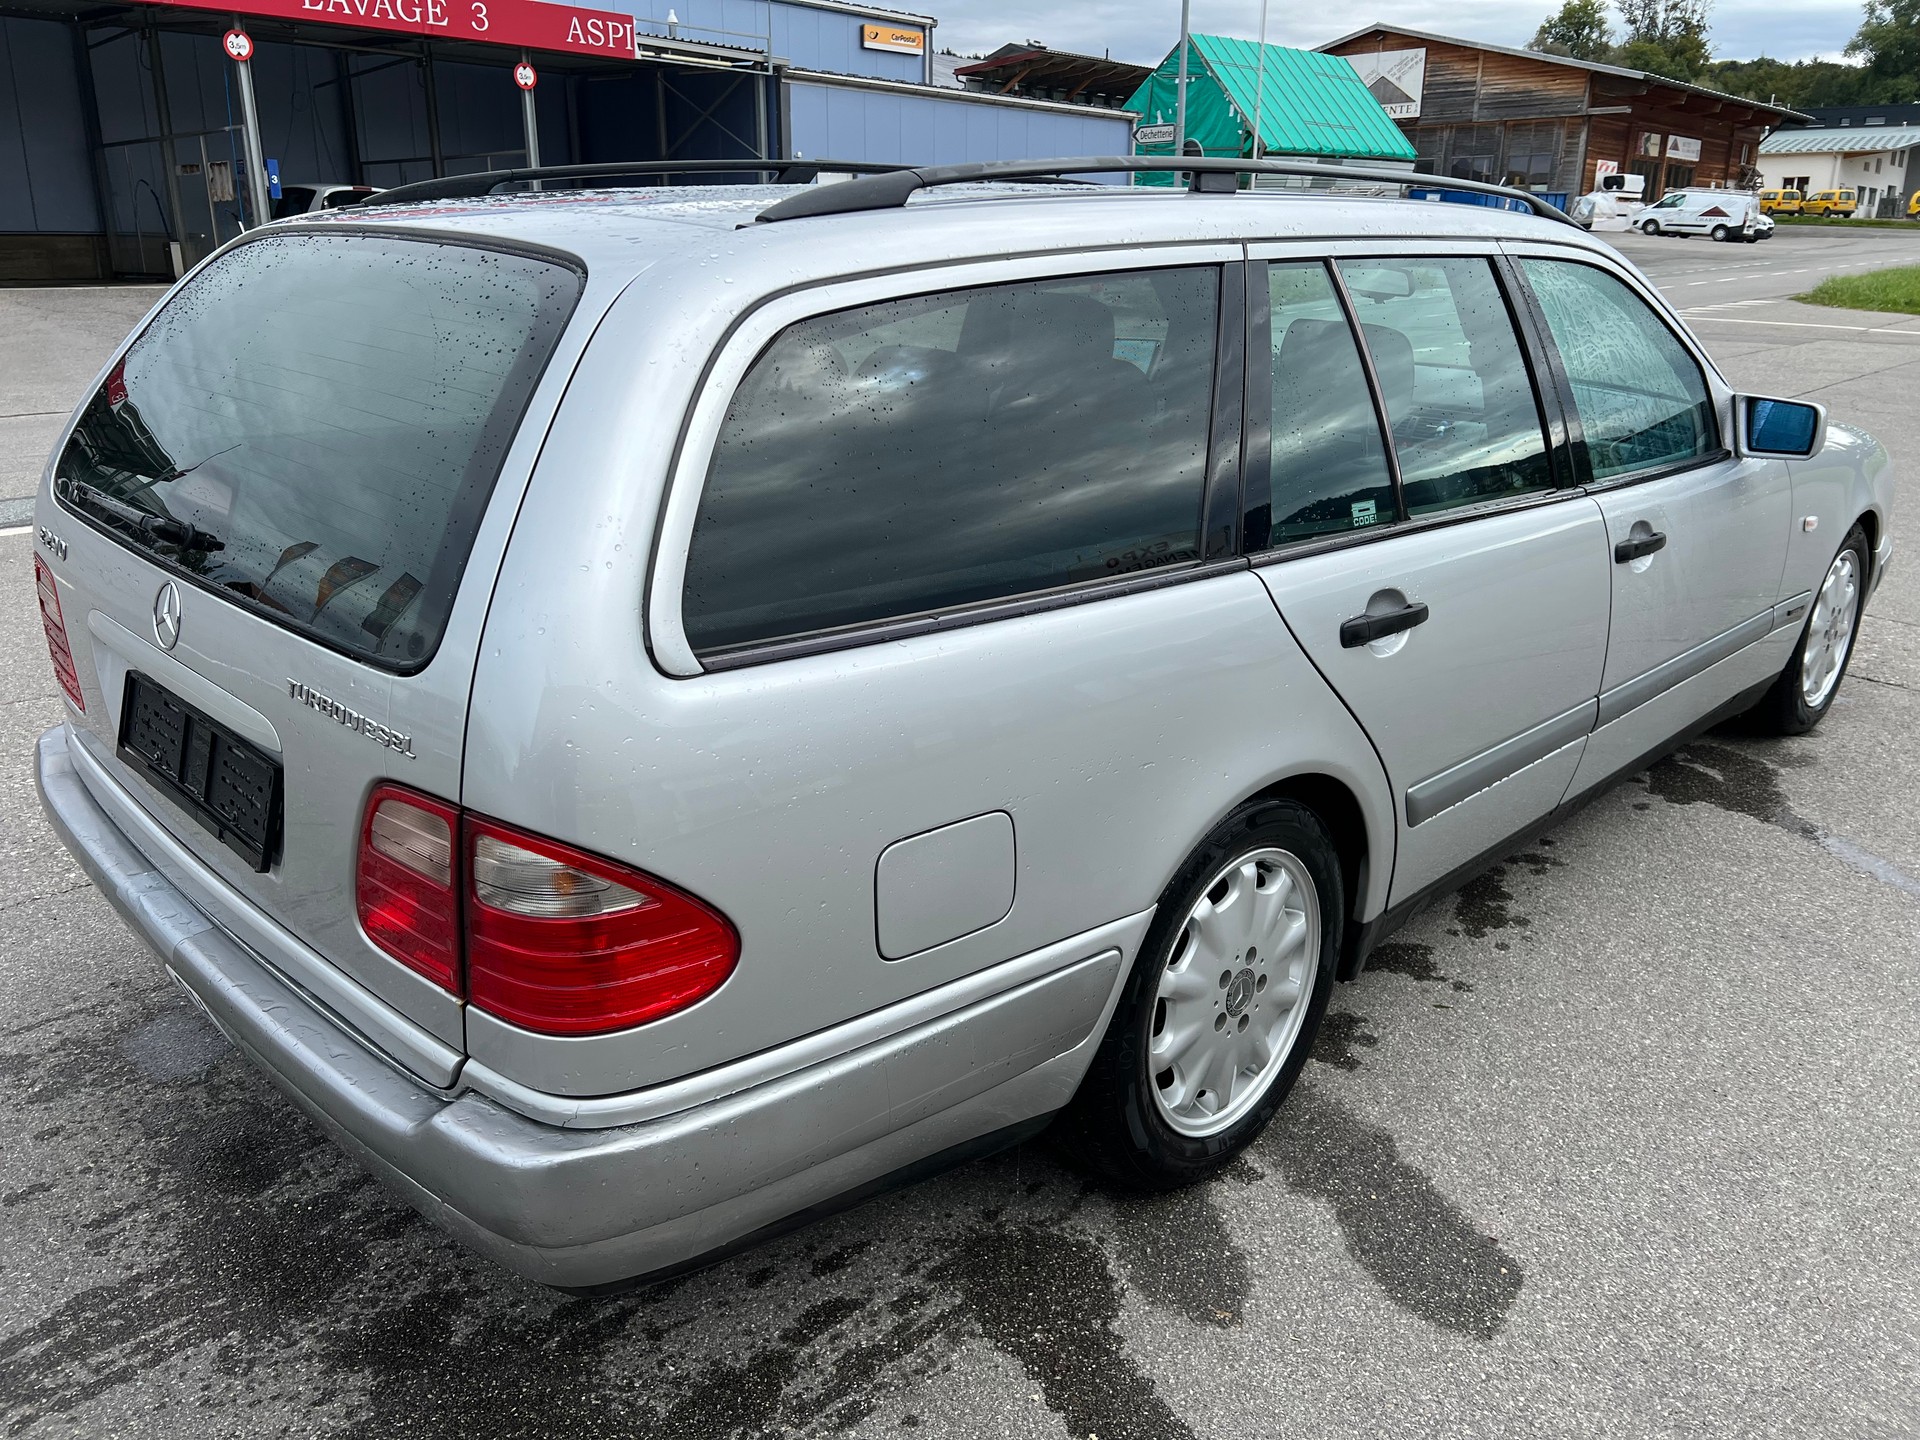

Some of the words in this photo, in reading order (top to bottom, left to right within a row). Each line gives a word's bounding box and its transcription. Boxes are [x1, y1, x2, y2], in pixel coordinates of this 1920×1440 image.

[471, 2, 489, 32] 3
[566, 16, 633, 50] ASPI
[891, 33, 917, 44] CarPostal
[1140, 128, 1173, 140] Déchetterie
[271, 174, 279, 184] 3
[1353, 514, 1377, 527] CODE!
[286, 677, 416, 760] TURBODIESEL
